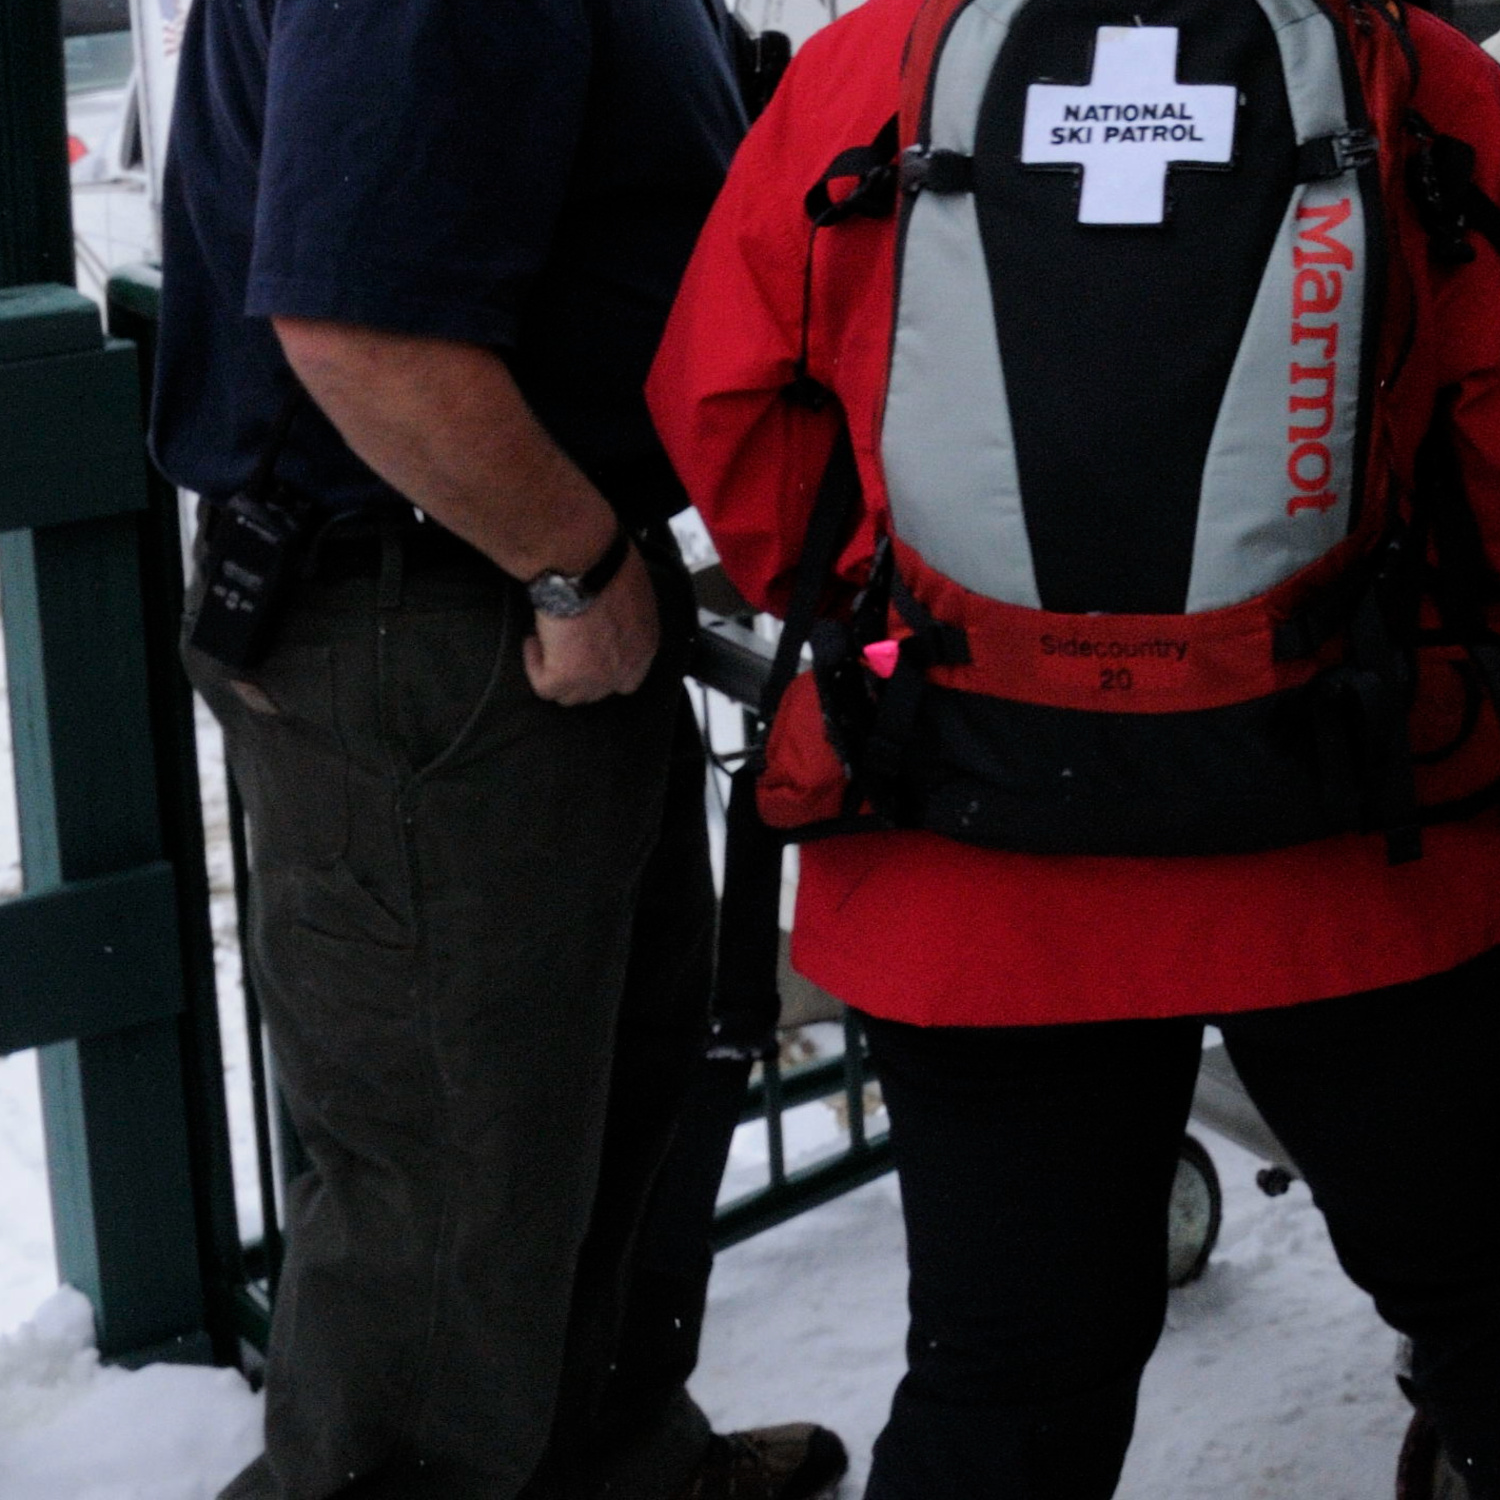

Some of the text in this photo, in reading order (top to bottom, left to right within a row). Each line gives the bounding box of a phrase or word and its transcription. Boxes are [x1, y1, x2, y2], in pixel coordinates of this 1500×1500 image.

[1063, 103, 1193, 122] NATIONAL
[1050, 124, 1203, 145] SKI PATROL
[1286, 197, 1354, 517] Marmot
[1039, 633, 1188, 661] Sidecountry
[1100, 668, 1133, 690] 20
